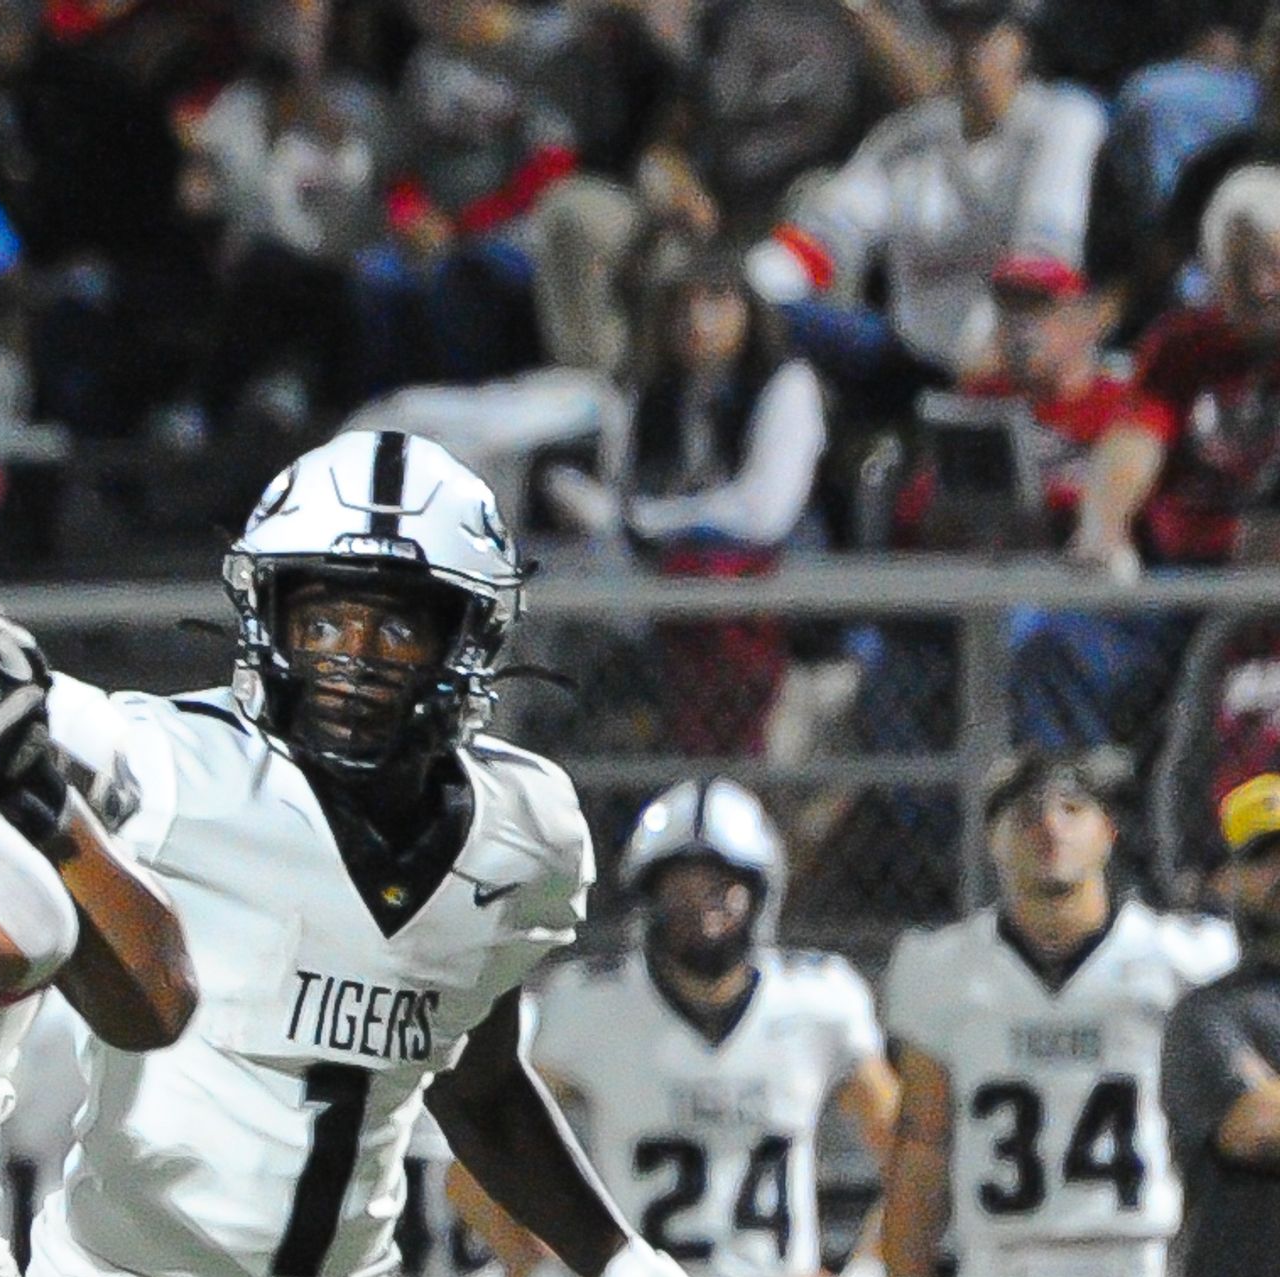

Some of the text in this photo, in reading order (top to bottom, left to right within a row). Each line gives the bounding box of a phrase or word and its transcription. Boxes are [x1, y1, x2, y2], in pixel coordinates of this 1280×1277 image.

[286, 969, 441, 1062] TIGERS
[633, 1134, 792, 1263] 24
[973, 1073, 1144, 1217] 34
